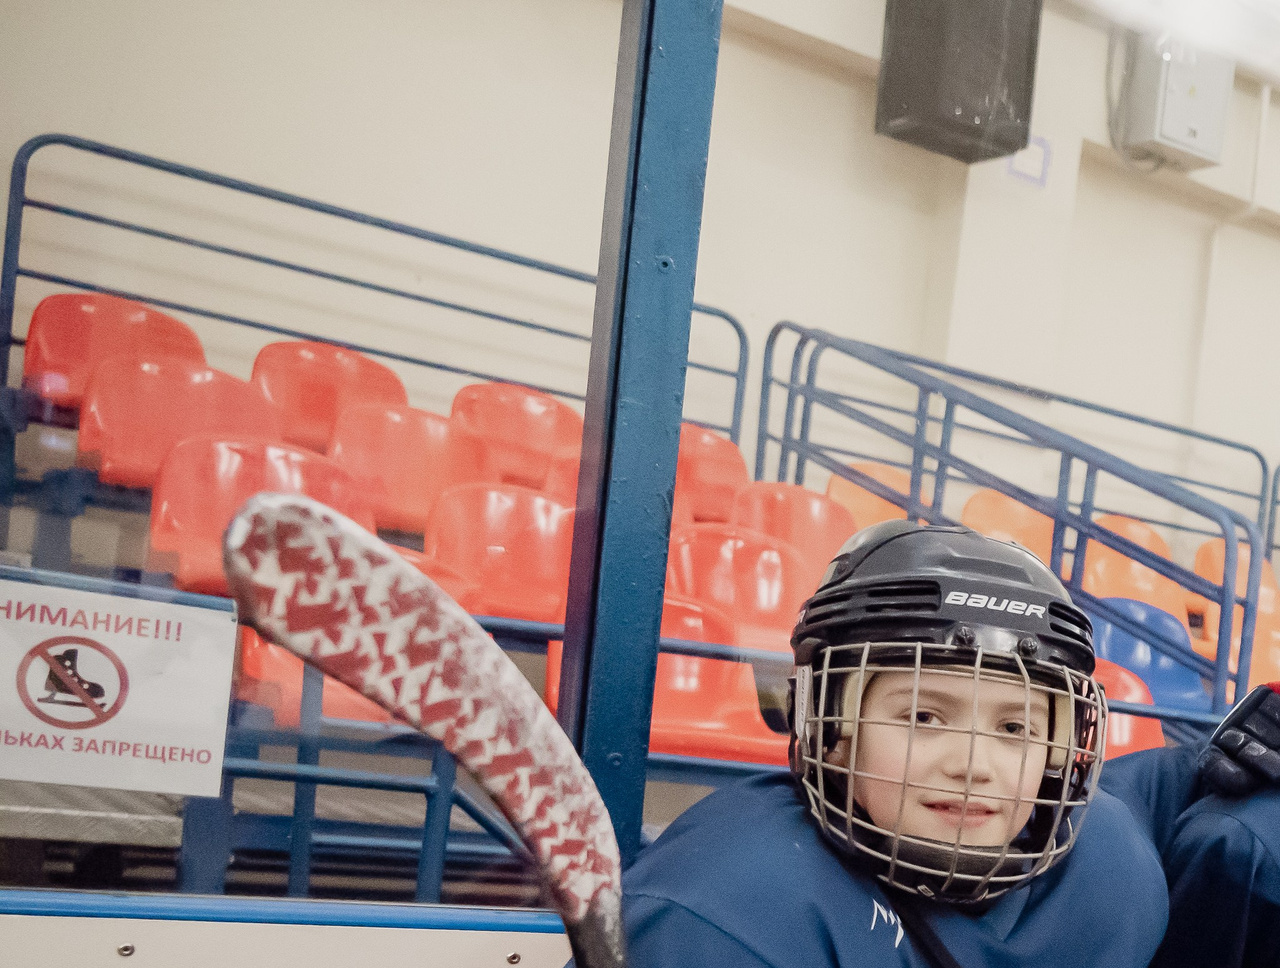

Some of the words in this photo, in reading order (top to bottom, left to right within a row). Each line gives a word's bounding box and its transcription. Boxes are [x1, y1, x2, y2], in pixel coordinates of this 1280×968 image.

[944, 590, 1047, 619] BAUER
[0, 729, 65, 751] ЬКАХ
[72, 737, 213, 765] ЗАПРЕЩЕНО
